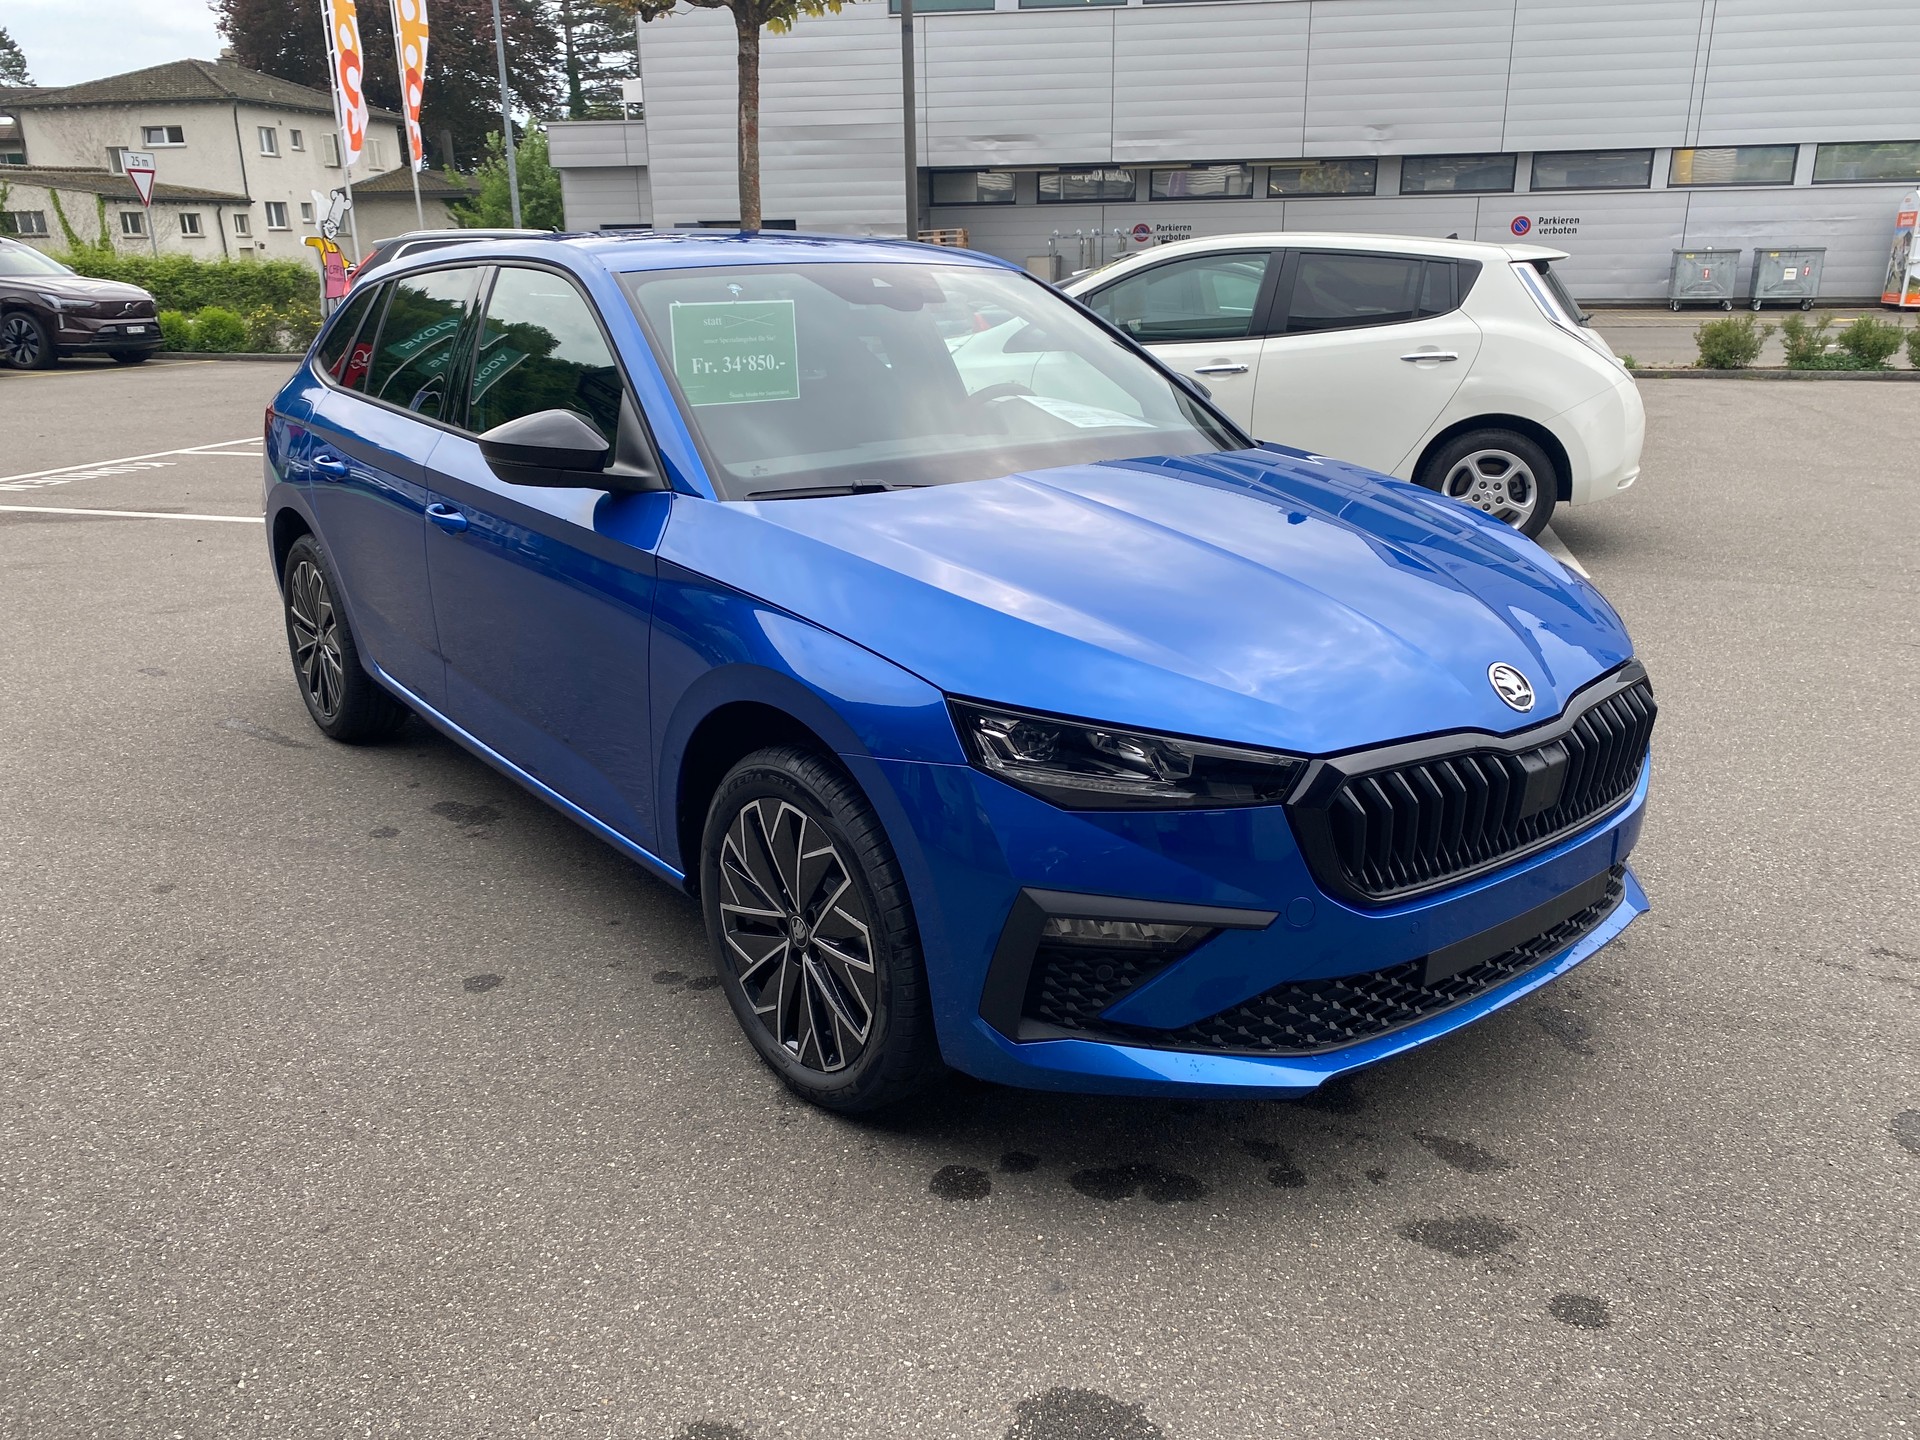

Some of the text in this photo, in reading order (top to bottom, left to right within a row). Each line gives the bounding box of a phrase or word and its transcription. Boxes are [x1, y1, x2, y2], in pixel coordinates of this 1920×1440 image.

[130, 155, 149, 167] 25 m
[1538, 216, 1580, 225] Parkieren
[1156, 223, 1192, 232] Parkieren
[1538, 226, 1577, 235] verboten
[1156, 233, 1191, 241] verboten
[703, 317, 722, 326] statt
[691, 357, 718, 375] Fr.
